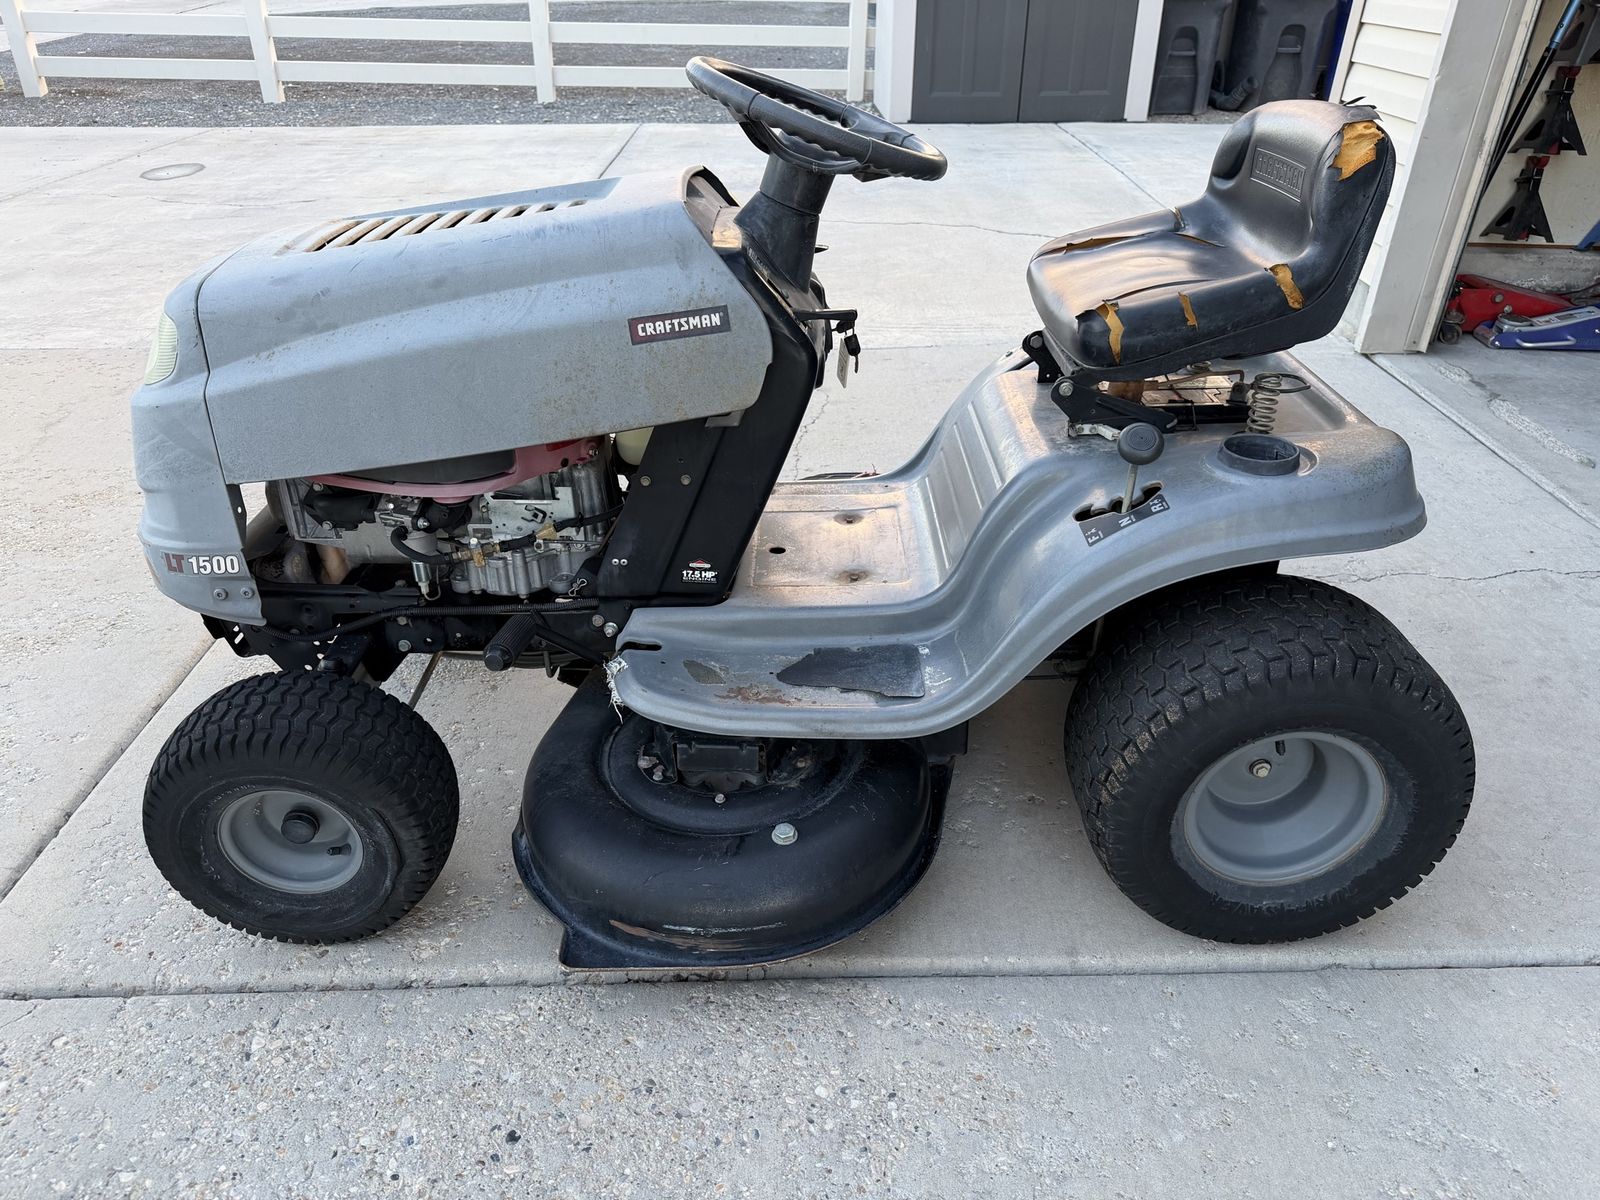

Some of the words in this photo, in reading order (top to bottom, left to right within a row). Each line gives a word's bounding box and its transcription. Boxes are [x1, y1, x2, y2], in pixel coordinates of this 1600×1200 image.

[637, 312, 721, 337] CRAFTSMAN
[1118, 516, 1132, 527] N
[163, 552, 185, 574] LT
[188, 555, 240, 575] 1500
[682, 570, 701, 578] 17.5
